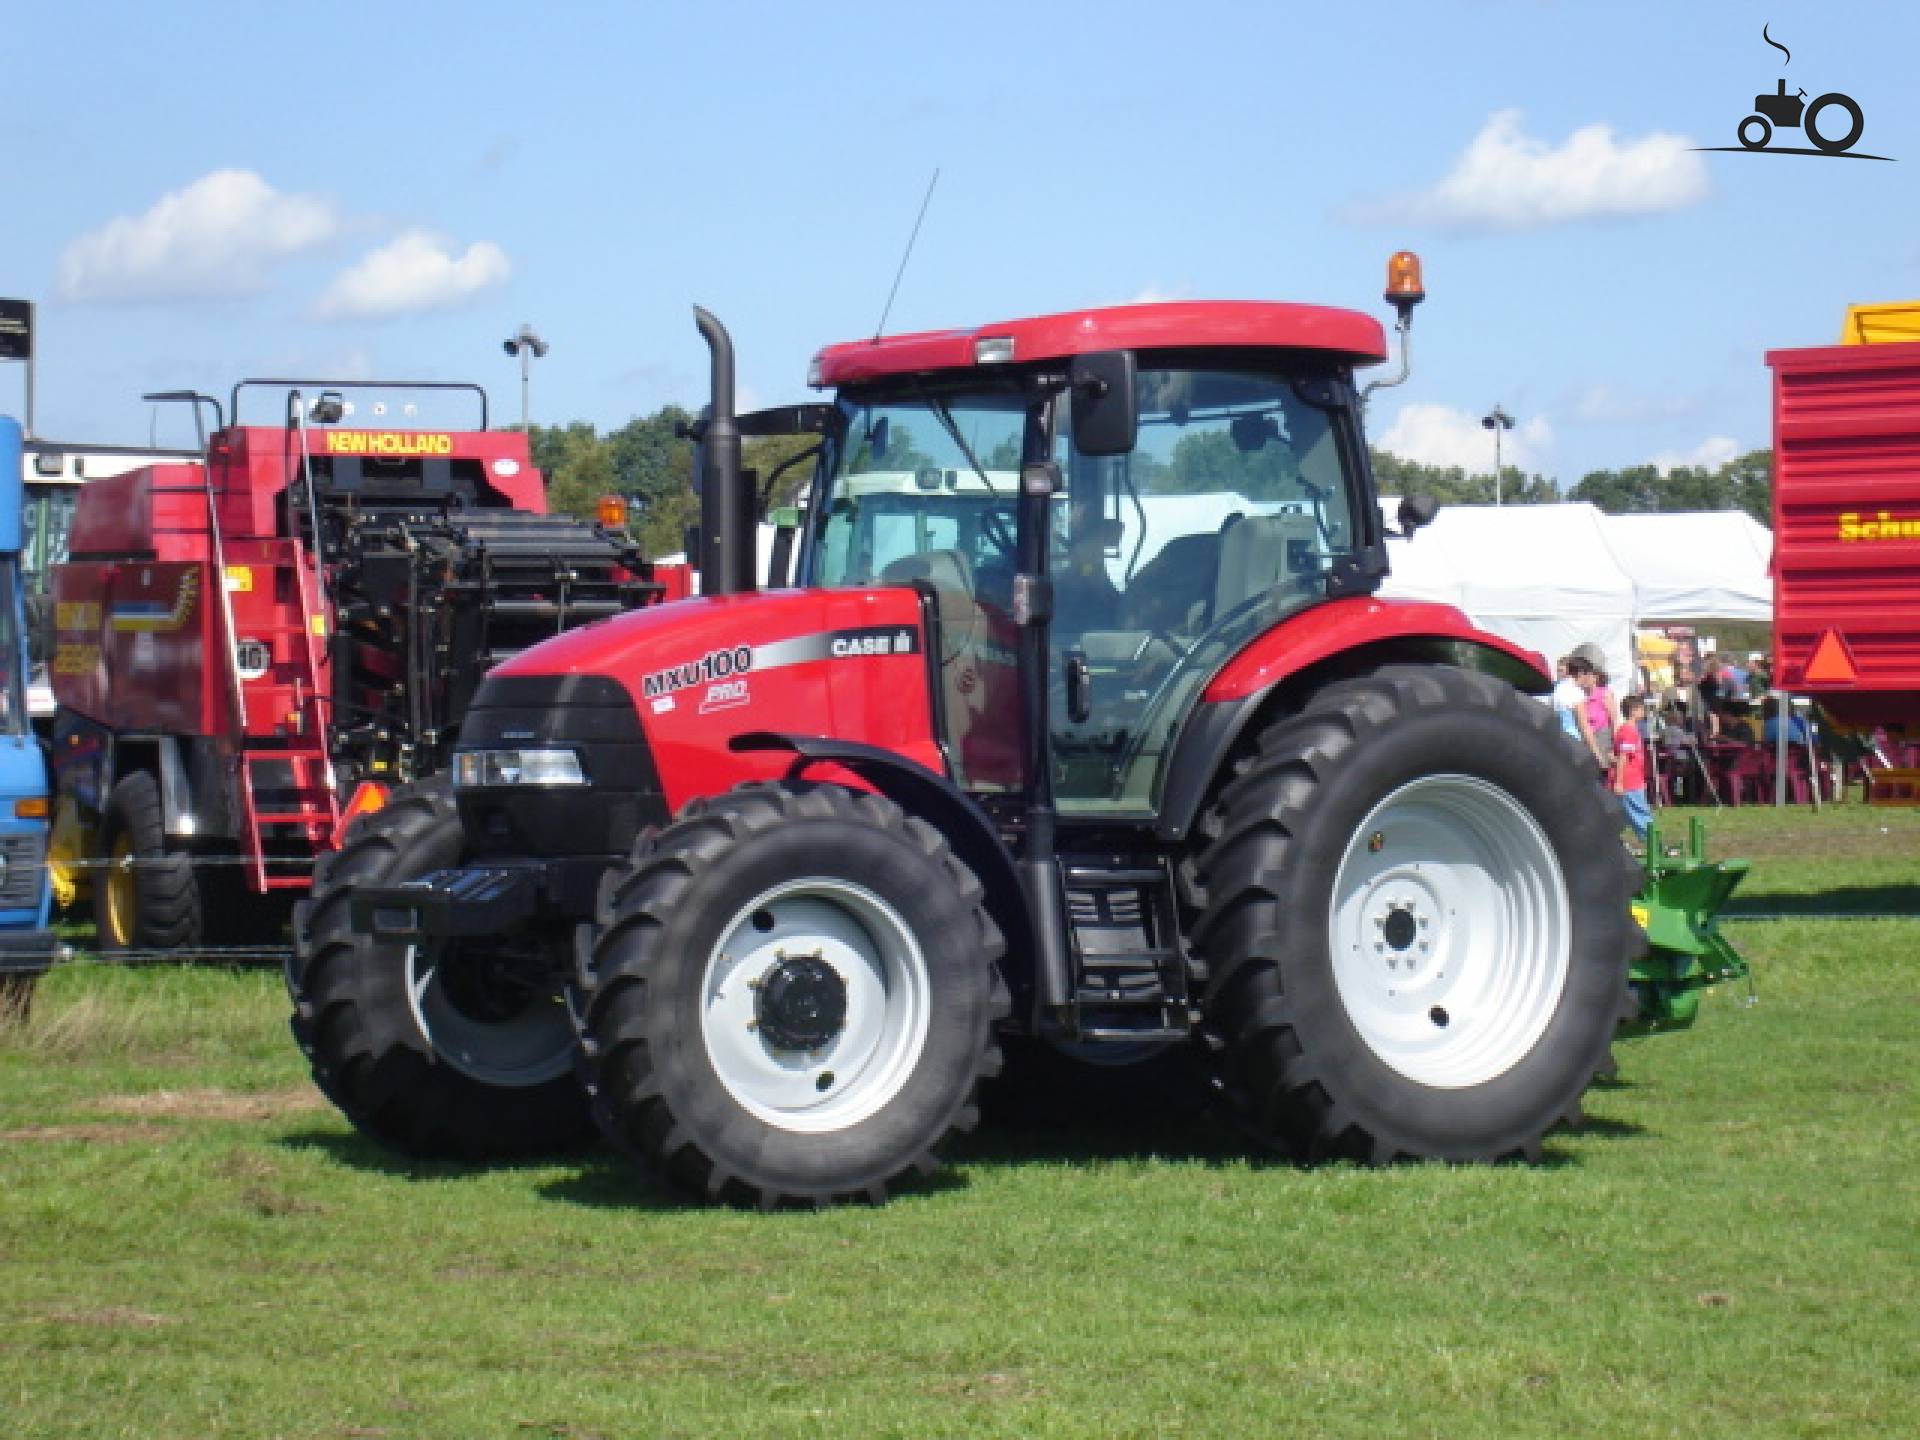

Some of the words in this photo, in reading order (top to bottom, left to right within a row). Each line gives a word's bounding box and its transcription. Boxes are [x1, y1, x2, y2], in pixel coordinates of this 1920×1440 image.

[327, 431, 366, 453] NEW
[368, 433, 453, 454] HOLLAND
[831, 635, 889, 657] CASE
[641, 644, 752, 699] MXU100
